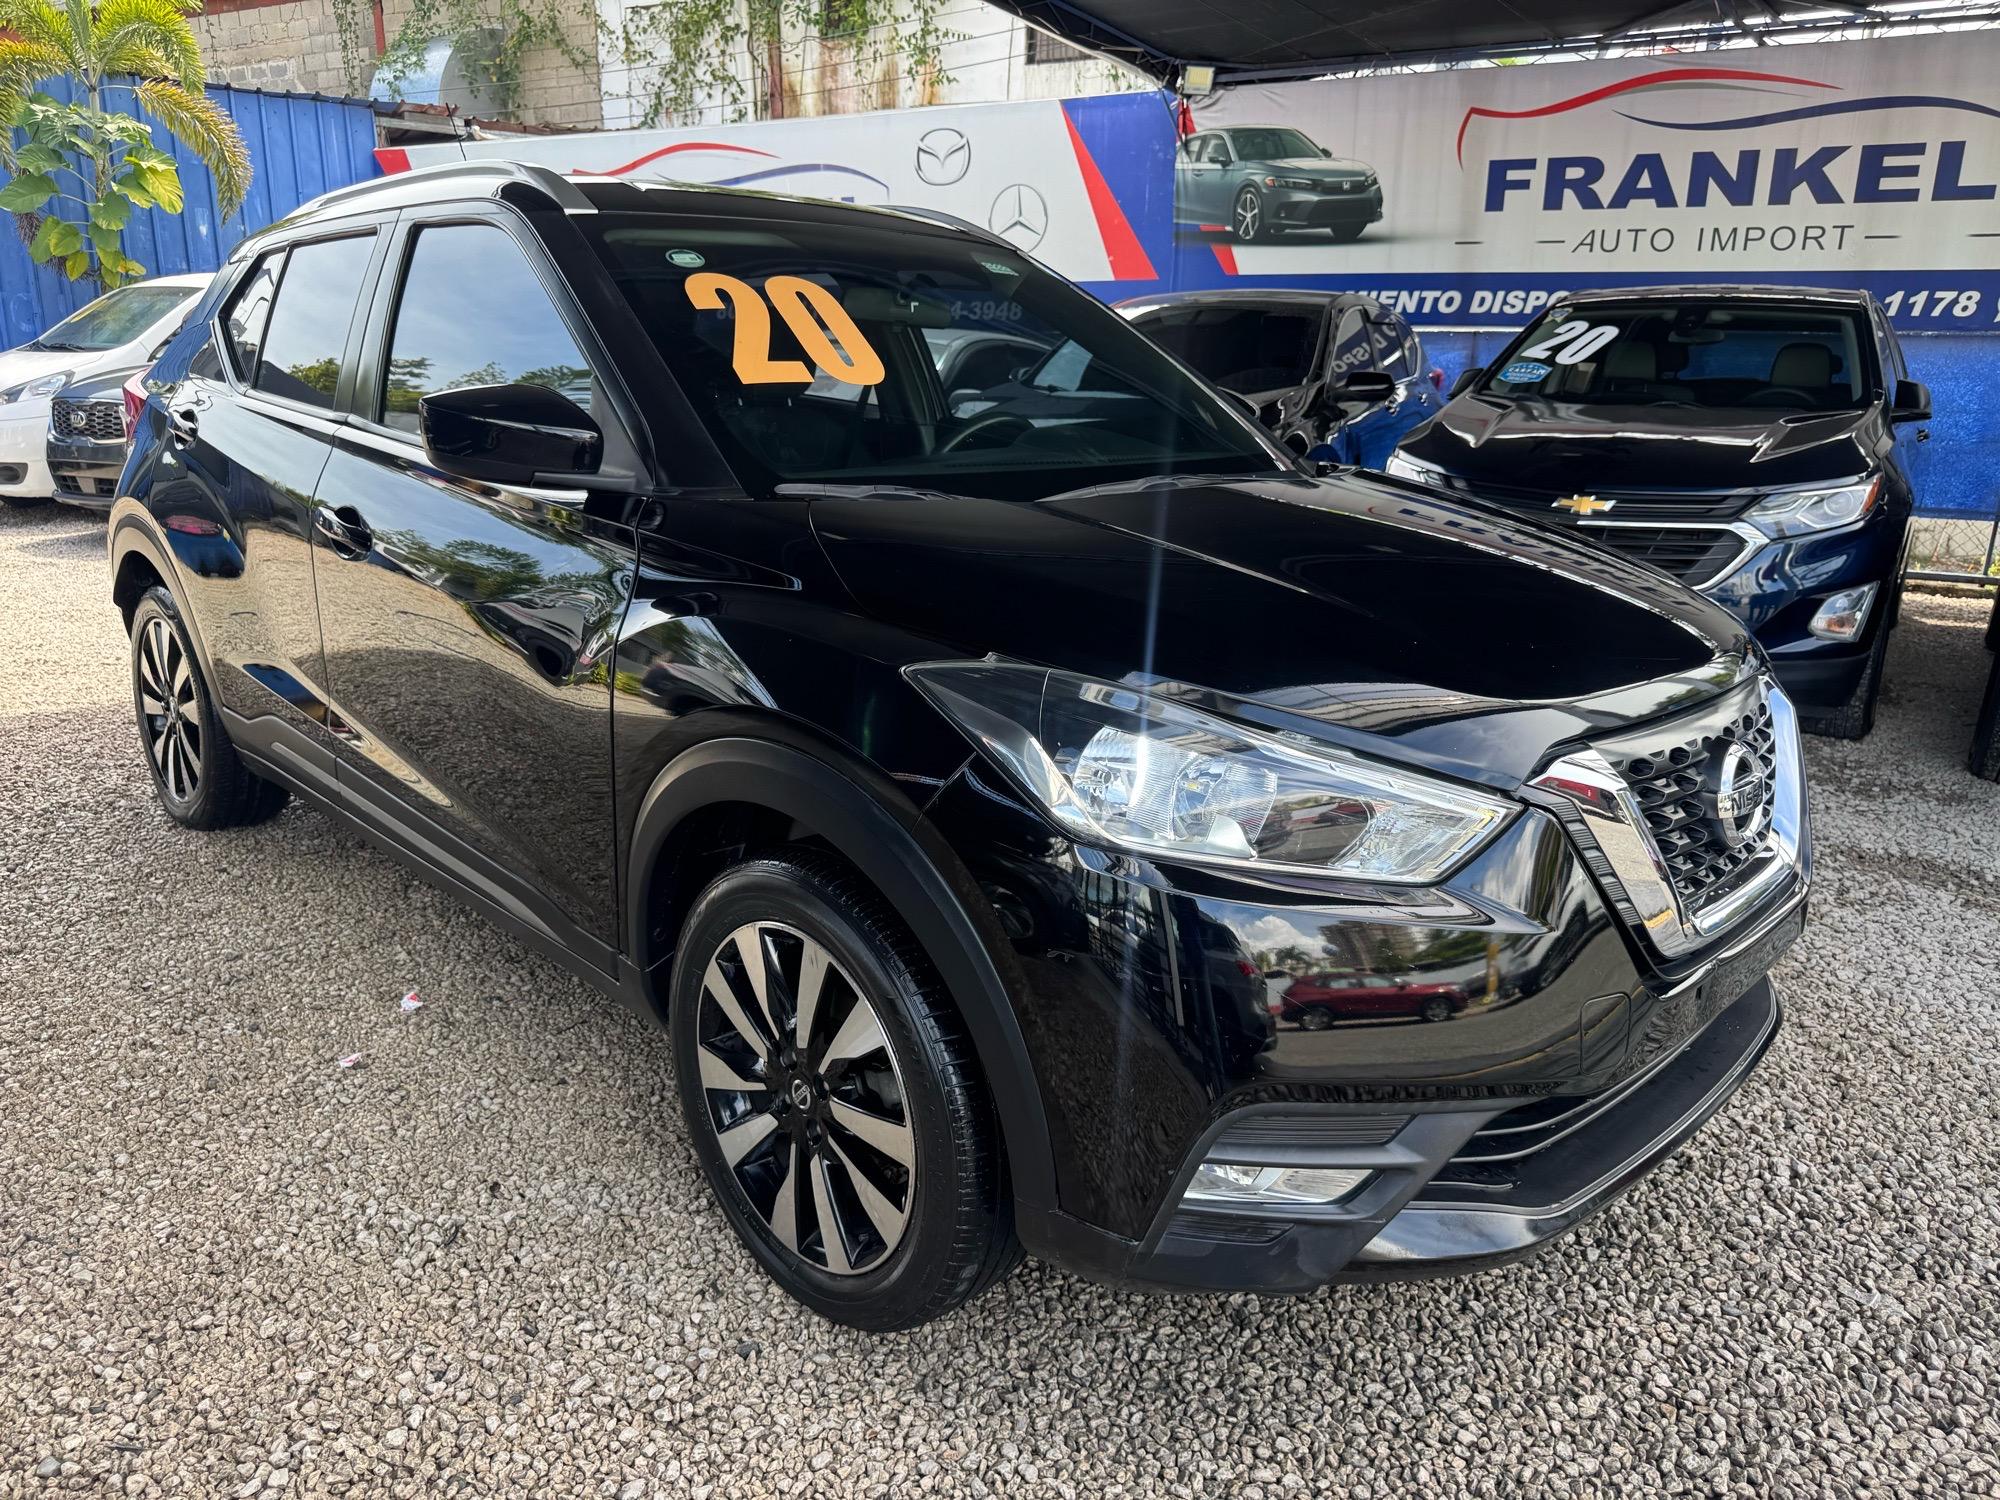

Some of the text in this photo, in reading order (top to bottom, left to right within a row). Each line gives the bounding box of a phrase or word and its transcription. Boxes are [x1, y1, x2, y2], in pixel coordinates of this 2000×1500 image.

[1484, 140, 1997, 213] FRANKEL
[1571, 225, 1855, 253] AUTO IMPORT
[1884, 290, 1981, 317] 1178
[684, 272, 886, 386] 20
[1521, 320, 1619, 365] 20
